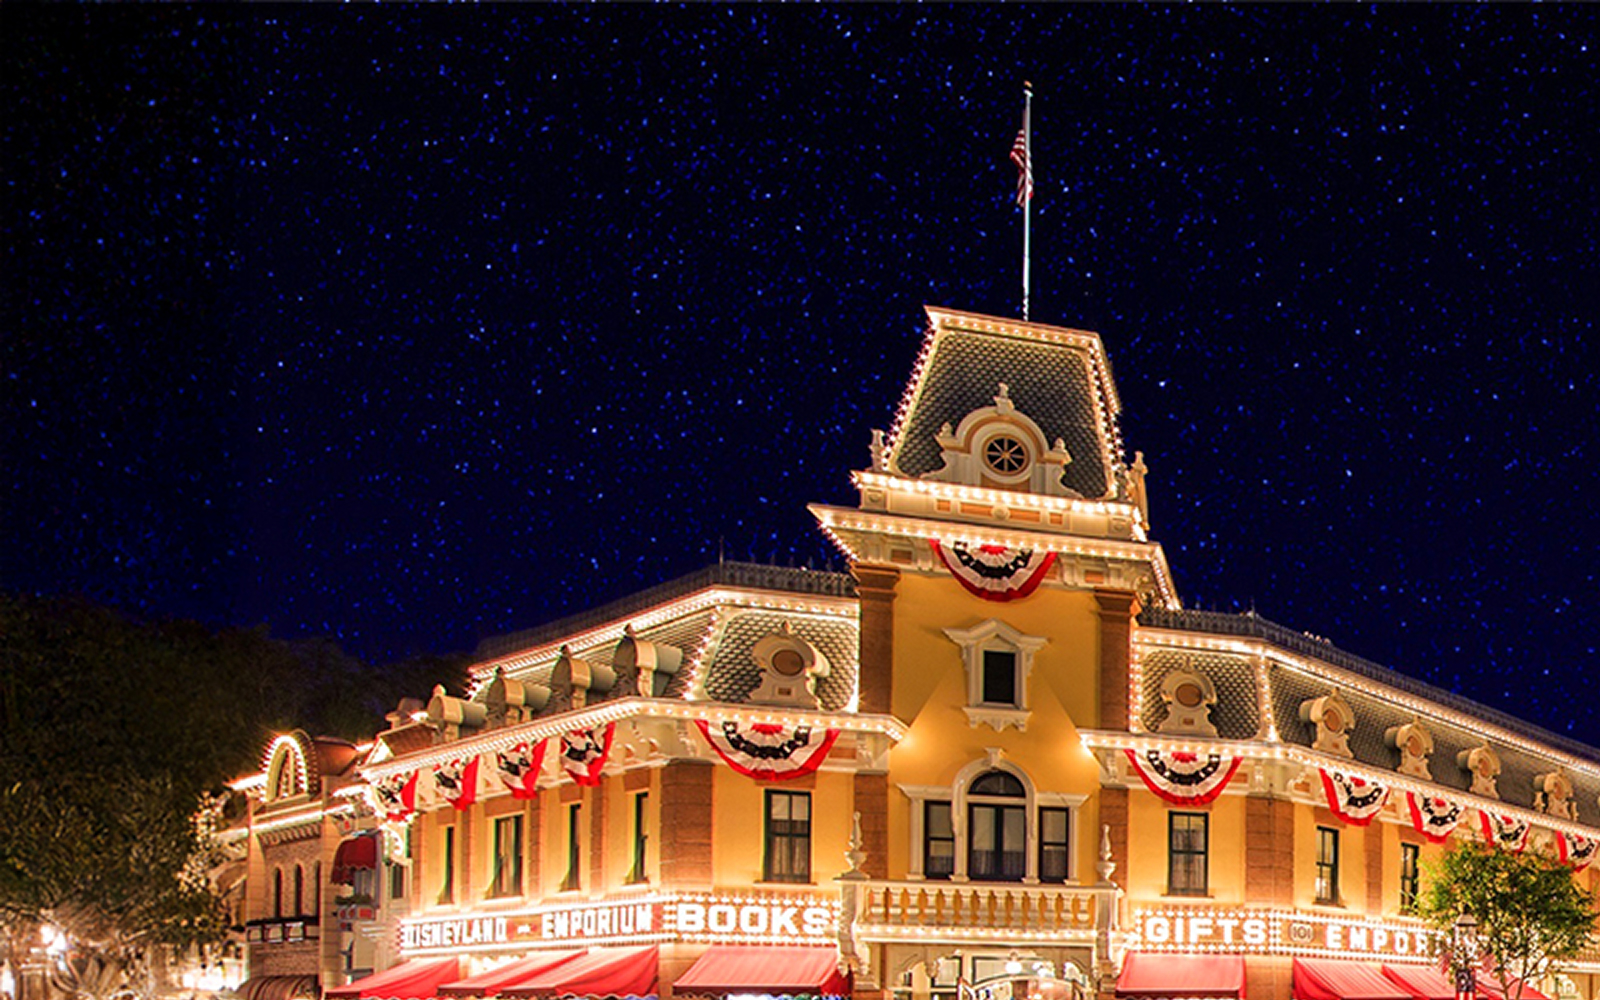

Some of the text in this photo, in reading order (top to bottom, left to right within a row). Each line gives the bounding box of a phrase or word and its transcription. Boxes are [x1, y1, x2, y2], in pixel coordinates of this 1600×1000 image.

[404, 903, 654, 947] DISNEYLAND EMPORIUM
[677, 902, 832, 935] BOOKS
[1145, 916, 1267, 944] GIFTS
[1325, 924, 1478, 960] EMPOR
